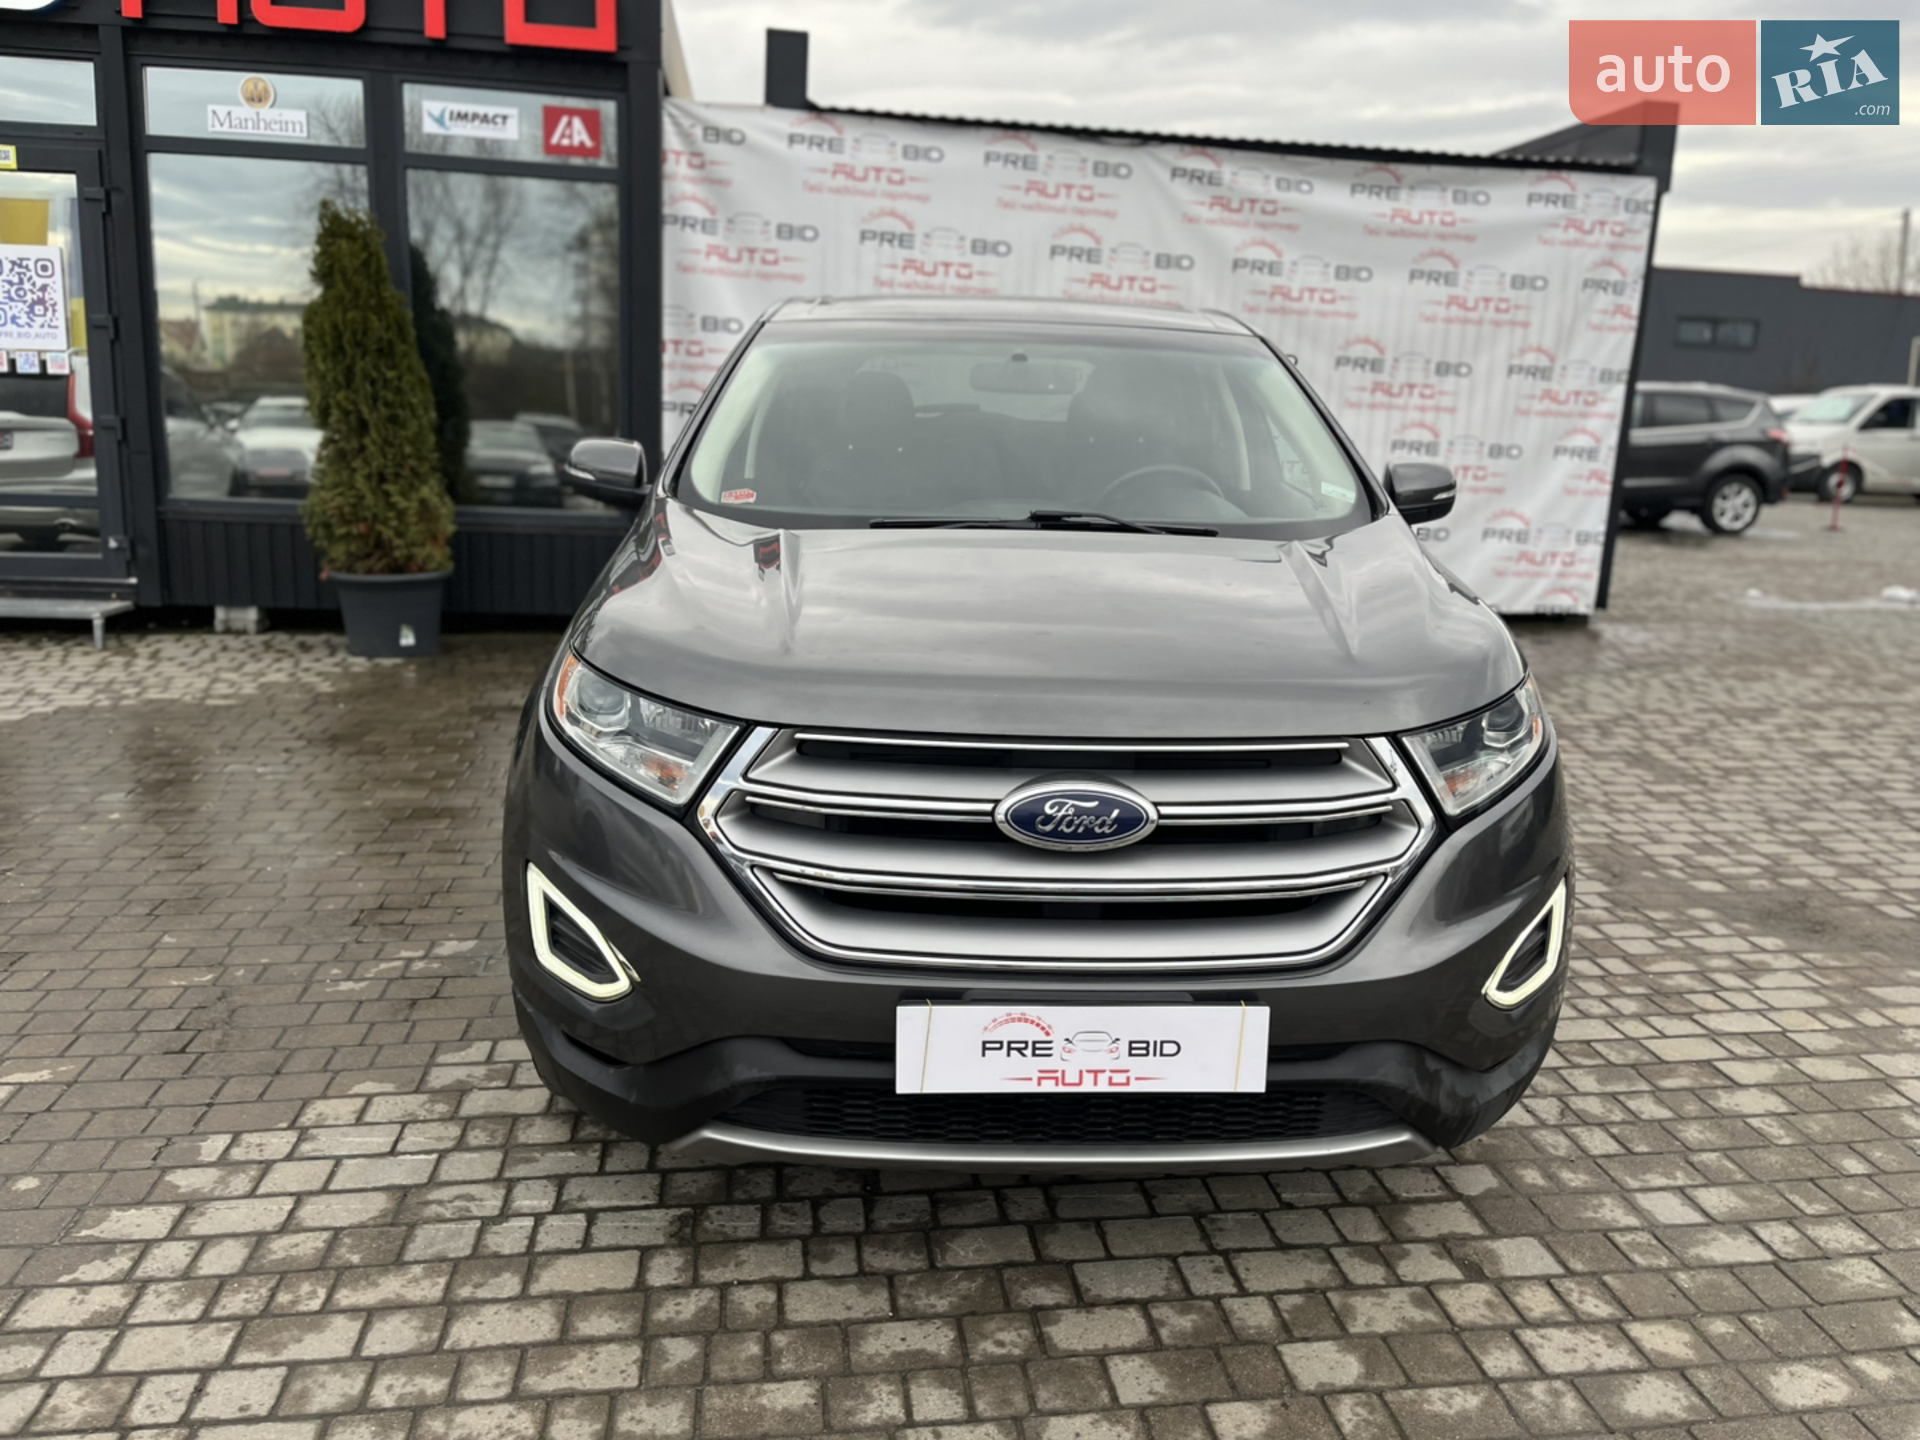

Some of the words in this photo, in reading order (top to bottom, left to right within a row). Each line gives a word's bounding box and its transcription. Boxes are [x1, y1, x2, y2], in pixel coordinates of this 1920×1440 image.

[210, 108, 306, 134] Manheim
[448, 109, 509, 127] IMPACT
[702, 125, 746, 146] BID
[788, 132, 845, 153] PRE
[902, 144, 944, 163] BID
[831, 163, 905, 186] AUTO
[983, 151, 1039, 171] PRE
[1092, 161, 1132, 179] BID
[1024, 180, 1095, 201] AUTO
[1170, 167, 1224, 187] PRE
[1275, 177, 1314, 194] BID
[1350, 182, 1400, 201] PRE
[1452, 189, 1490, 206] BID
[1527, 192, 1576, 210] PRE
[1208, 196, 1278, 216] AUTO
[1389, 208, 1457, 228] AUTO
[1562, 218, 1627, 237] AUTO
[775, 223, 819, 243] BID
[860, 229, 916, 250] PRE
[970, 239, 1012, 257] BID
[705, 244, 780, 265] AUTO
[1050, 244, 1103, 264] PRE
[1155, 253, 1195, 271] BID
[902, 258, 974, 280] AUTO
[1231, 258, 1283, 277] PRE
[1334, 264, 1373, 282] BID
[1088, 272, 1157, 294] AUTO
[1409, 269, 1458, 287] PRE
[1510, 275, 1549, 291] BID
[1269, 284, 1337, 304] AUTO
[1445, 294, 1511, 314] AUTO
[1335, 356, 1386, 374] PRE
[1371, 381, 1436, 399] AUTO
[1036, 798, 1120, 834] Ford
[981, 1040, 1054, 1058] PRE
[1128, 1040, 1181, 1058] BID
[1037, 1069, 1130, 1087] AUTO
